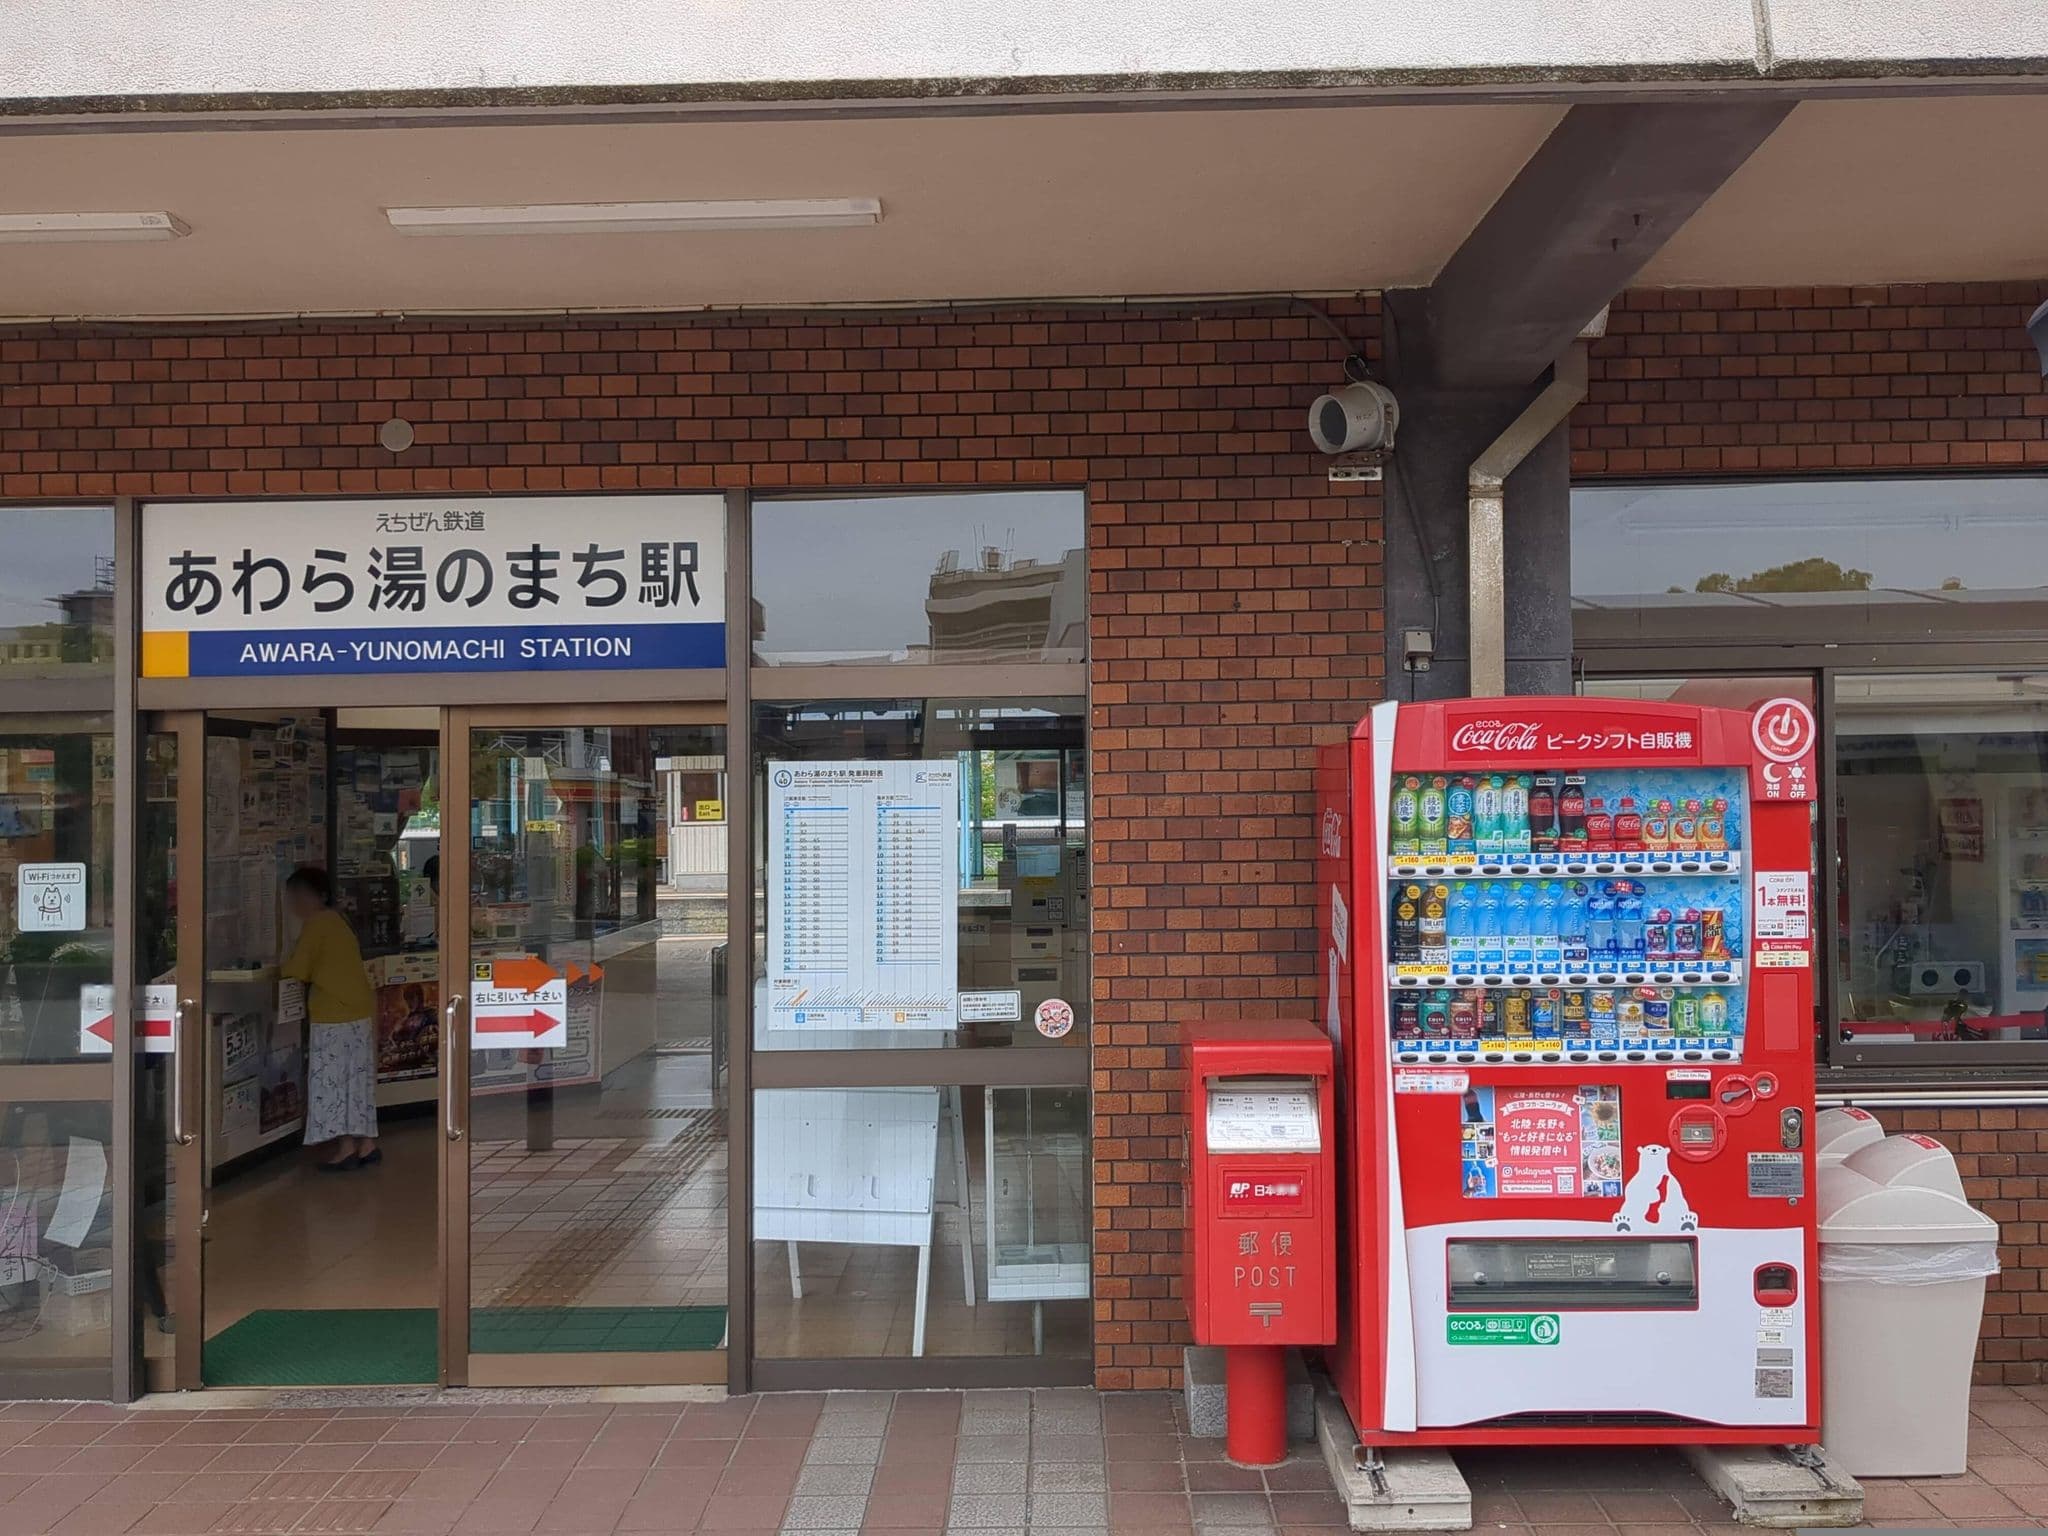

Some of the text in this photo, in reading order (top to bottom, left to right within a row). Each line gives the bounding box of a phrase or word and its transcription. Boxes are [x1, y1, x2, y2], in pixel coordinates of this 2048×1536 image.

[376, 511, 485, 533] えちぜん鉄道
[164, 541, 702, 616] あわら湯のまち駅
[240, 636, 632, 664] AWARA-YUNOMACHI STATION
[1452, 722, 1543, 752] Coca-Cola
[1546, 731, 1693, 750] ピークシフト自販機
[1766, 790, 1780, 798] ON
[475, 991, 562, 1004] 右に引いて下さい
[1510, 1118, 1566, 1129] 北陸・長野を
[1513, 1167, 1552, 1179] Instagram
[1254, 1184, 1299, 1197] 日本
[1239, 1231, 1293, 1256] 郵便
[1234, 1265, 1296, 1288] POST
